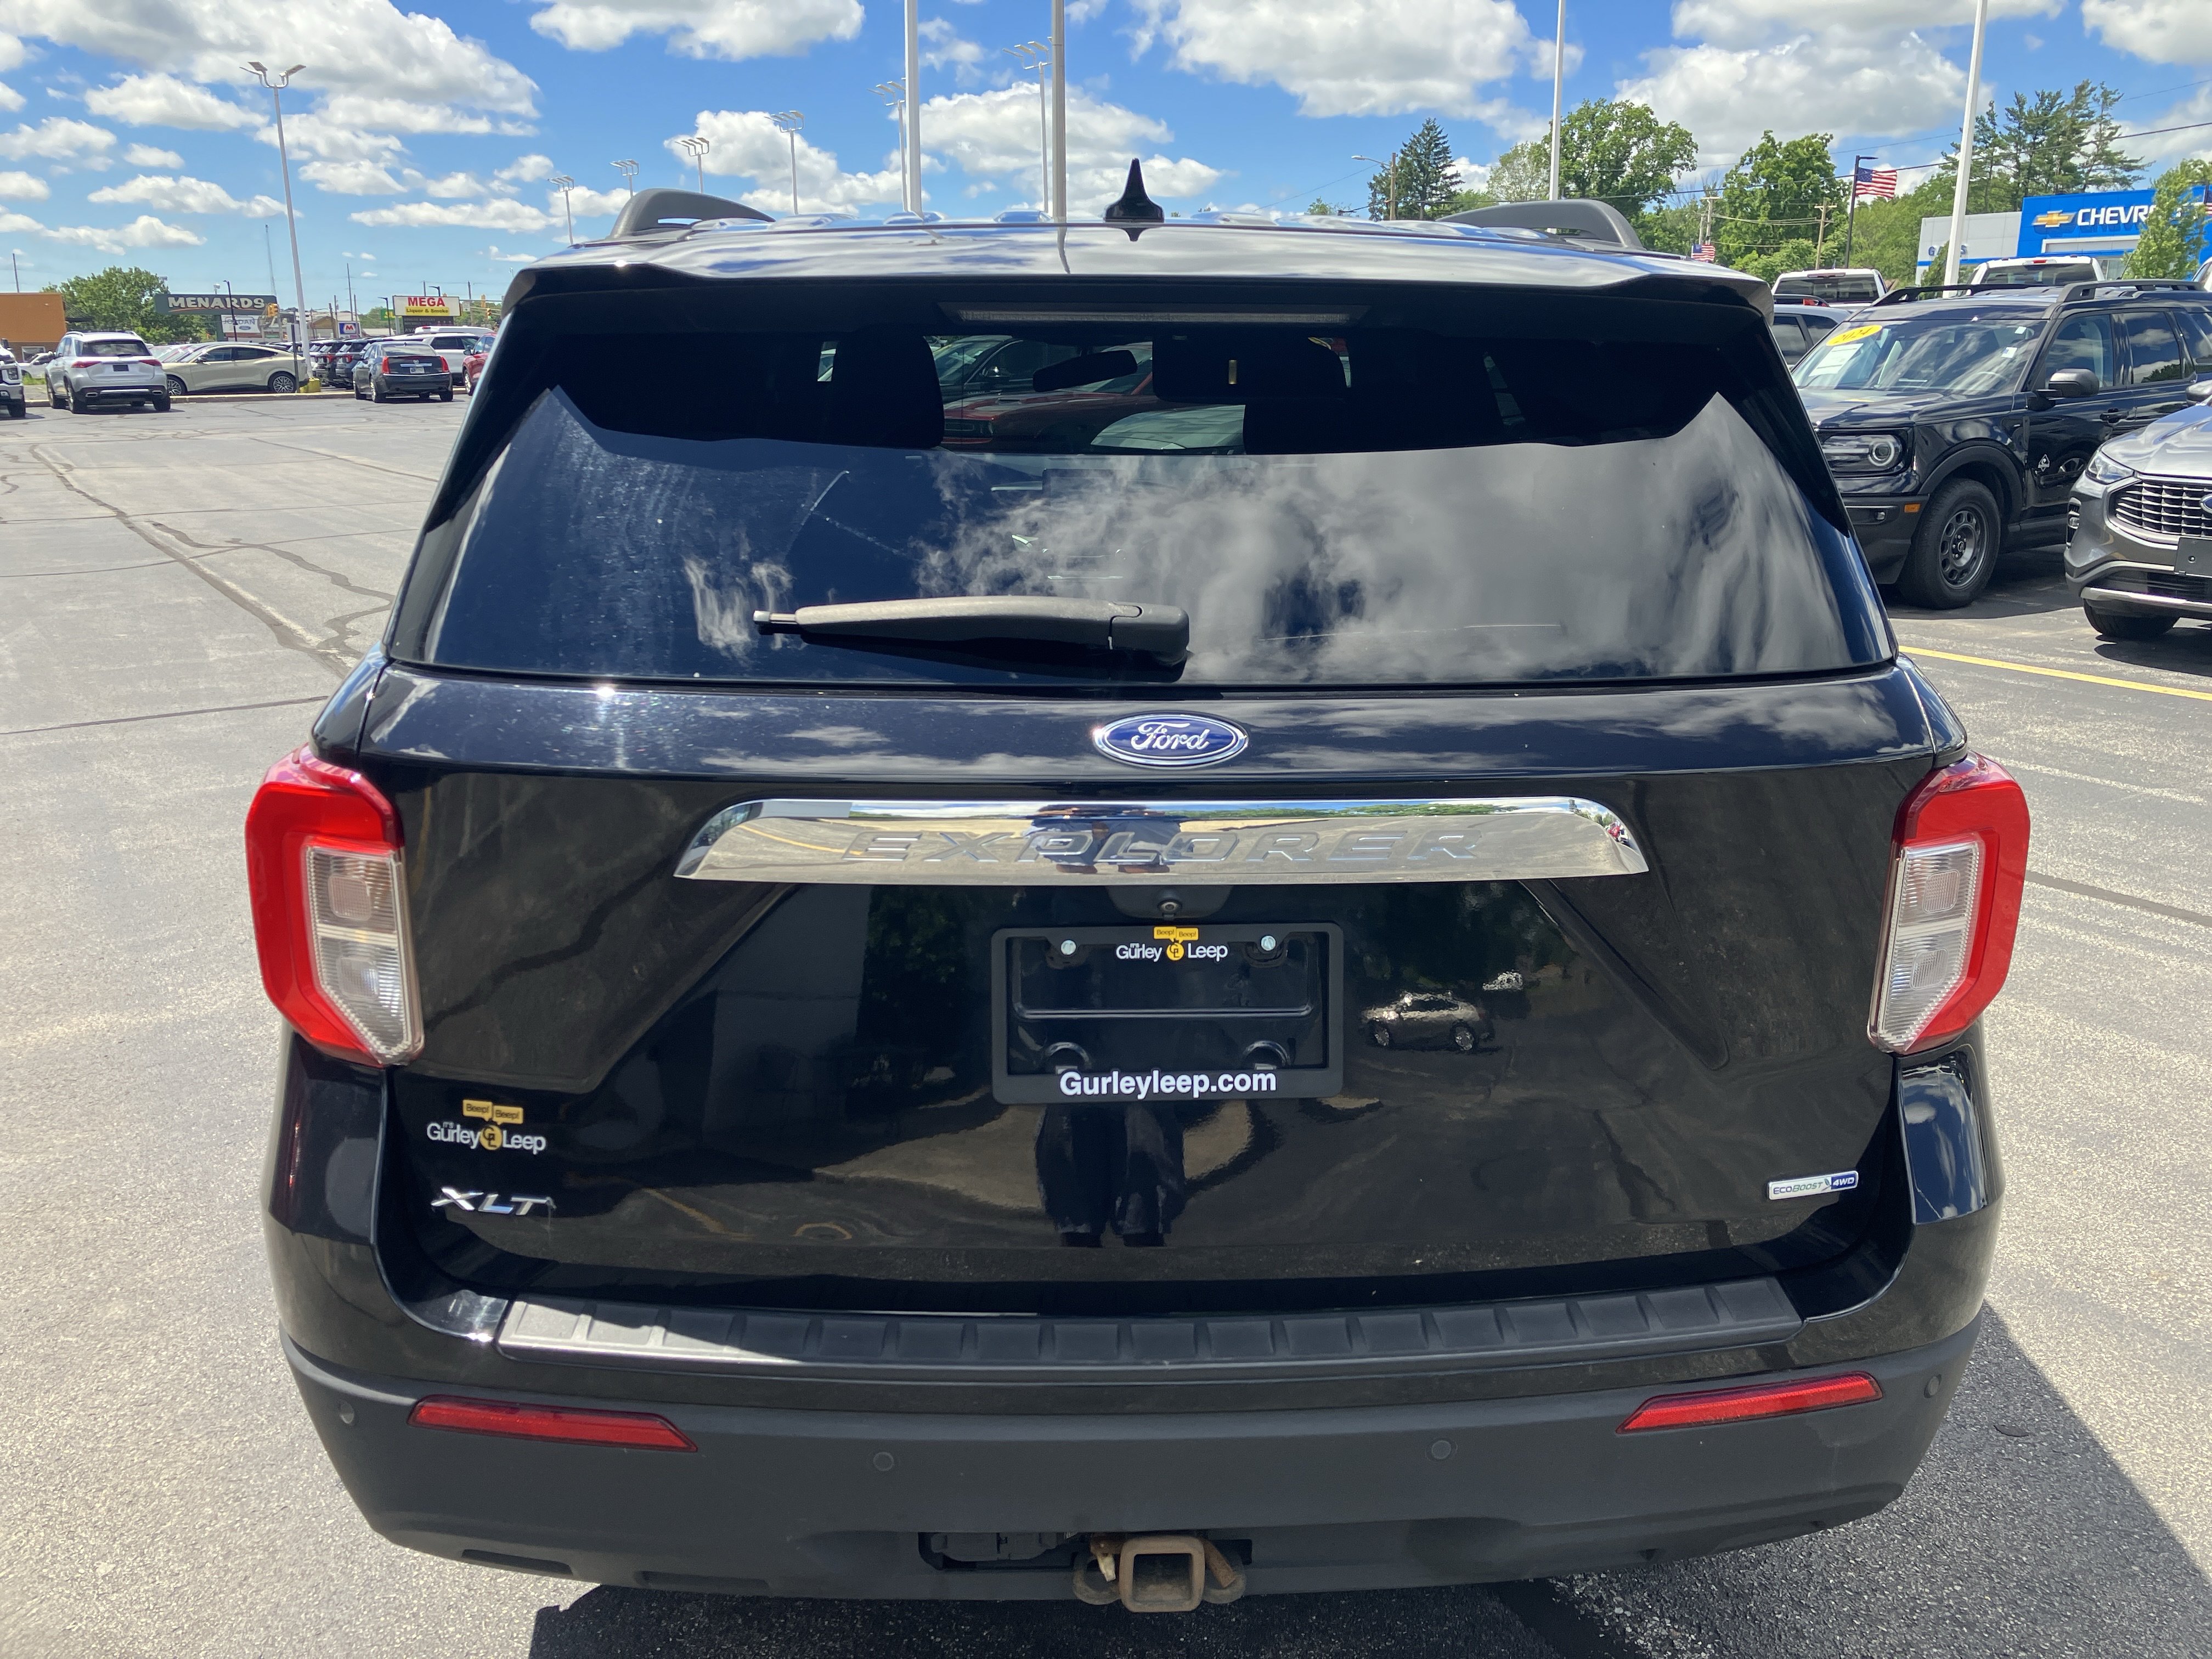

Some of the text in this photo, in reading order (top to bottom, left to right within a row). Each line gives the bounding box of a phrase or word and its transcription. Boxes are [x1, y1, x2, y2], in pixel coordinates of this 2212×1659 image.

[168, 297, 265, 308] MENARDS
[408, 297, 445, 307] MEGA
[1131, 721, 1209, 750] Ford
[840, 829, 1482, 863] EXPLORER
[1188, 943, 1228, 962] Leep
[1060, 1070, 1277, 1099] Gurleyleep.com
[466, 1104, 519, 1120] Beep! Beep!
[503, 1130, 546, 1154] Leep
[1773, 1177, 1855, 1194] ECOBOOST 4WD
[431, 1187, 549, 1215] XLT
